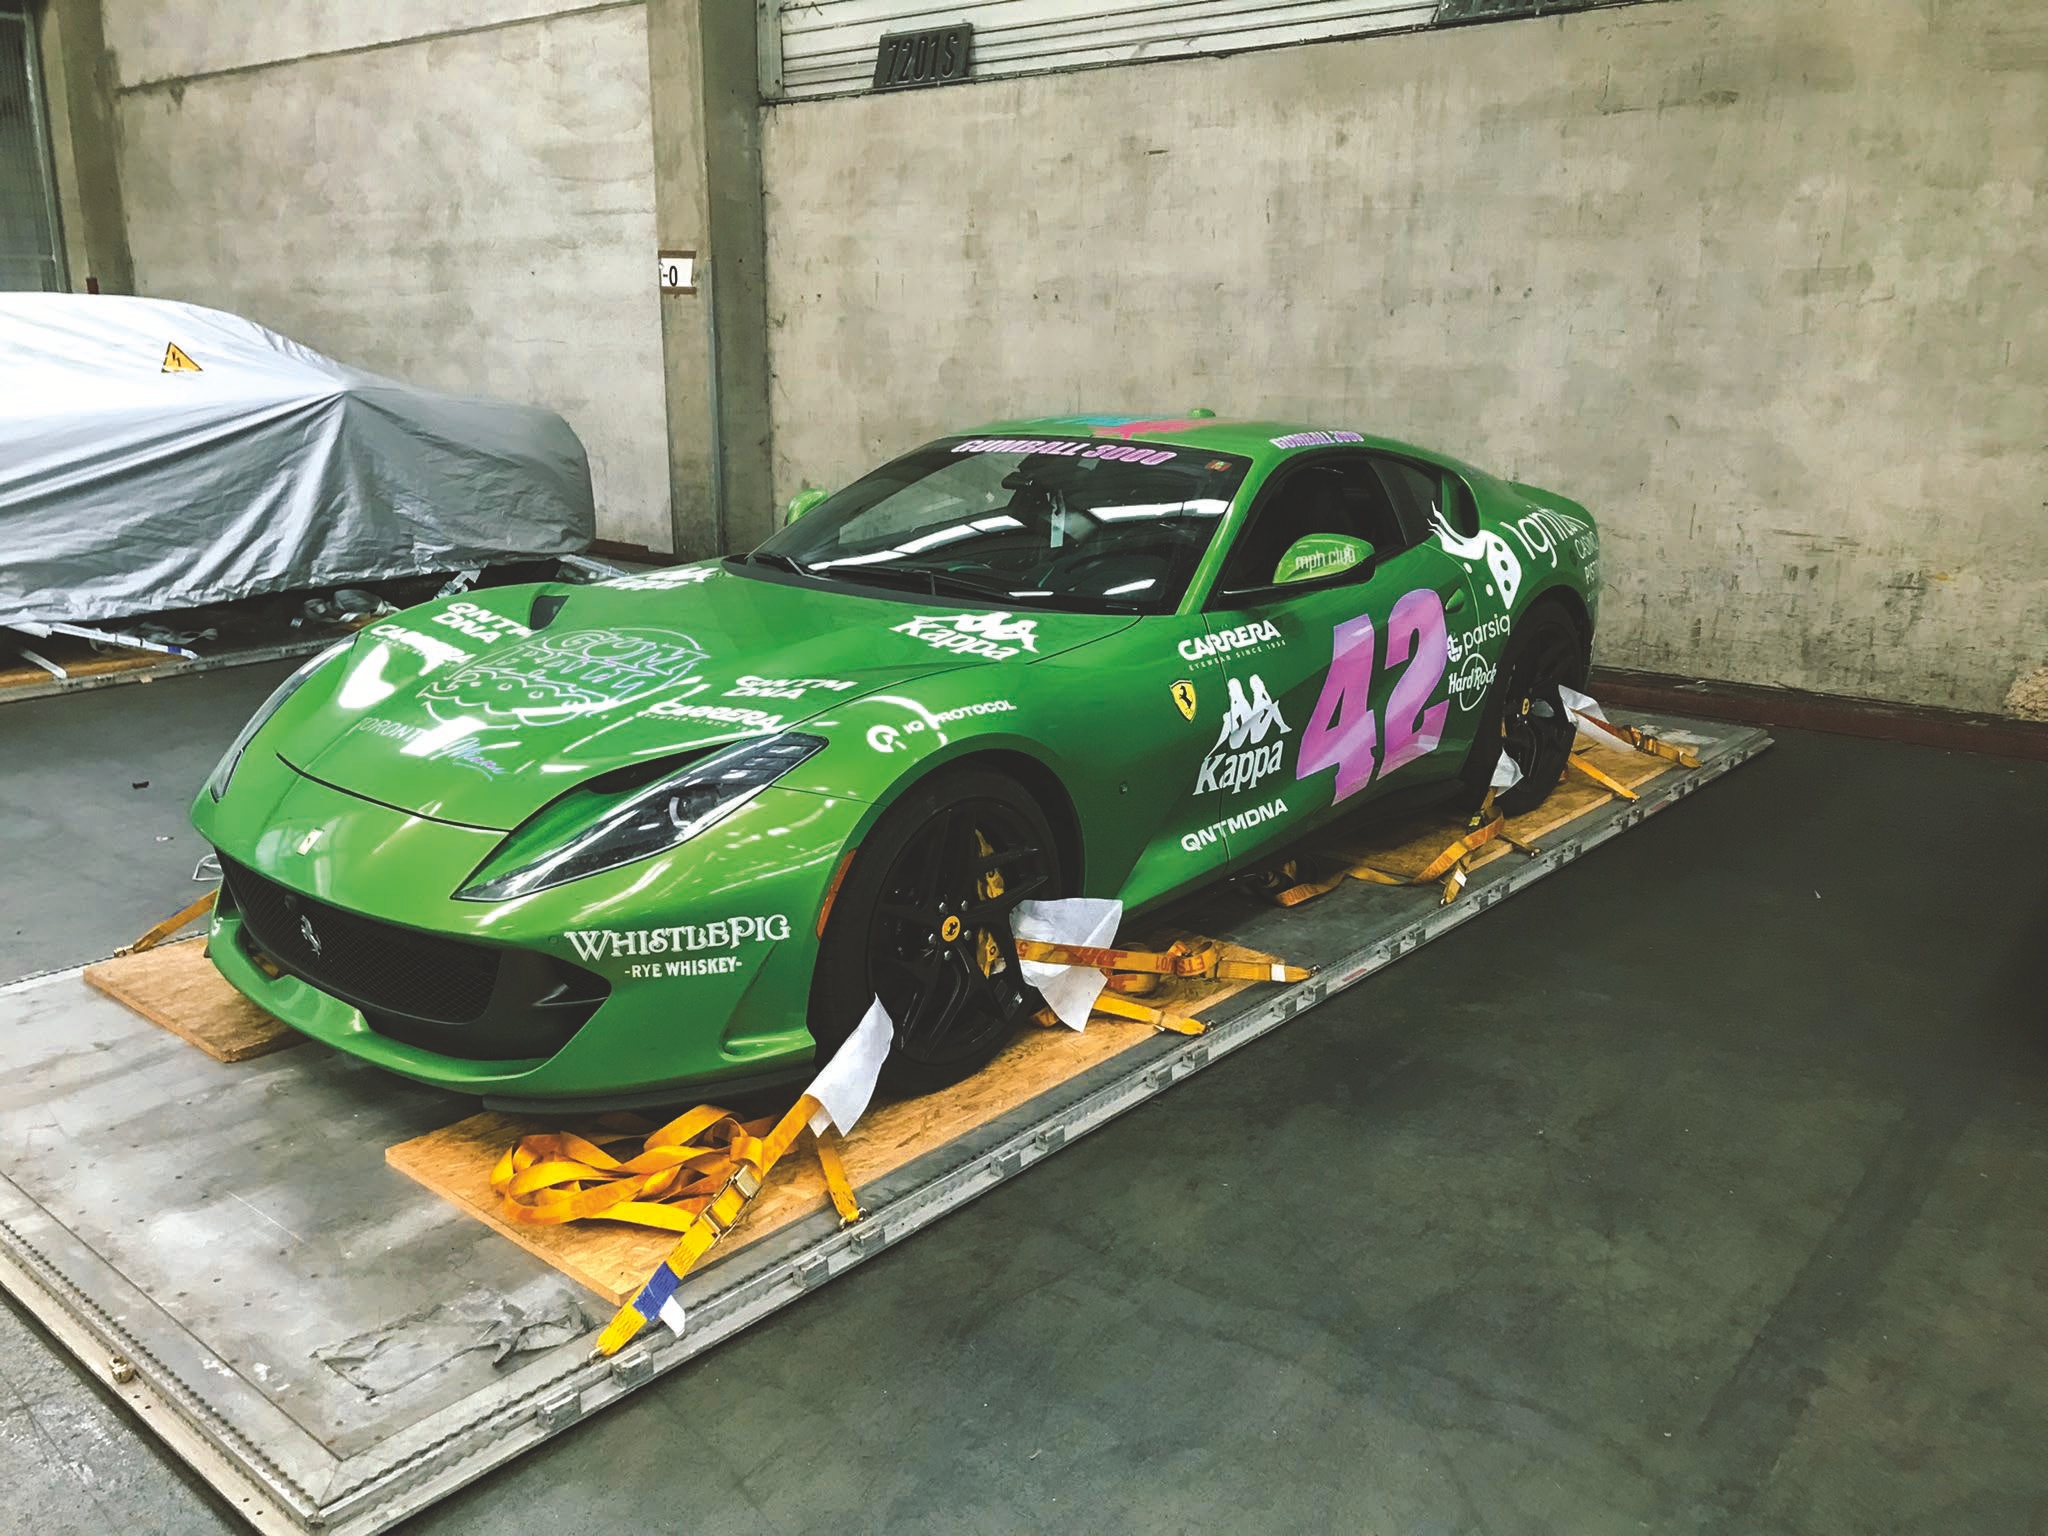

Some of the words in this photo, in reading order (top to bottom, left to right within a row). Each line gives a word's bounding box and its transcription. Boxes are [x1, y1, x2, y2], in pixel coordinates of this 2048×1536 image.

[1081, 444, 1178, 466] 3000
[431, 612, 503, 644] DNA
[889, 615, 1020, 661] Kappa
[1178, 619, 1282, 661] CARRERA
[1462, 613, 1511, 656] parsiq
[1295, 588, 1450, 807] 42
[1448, 668, 1475, 695] Hard
[1473, 662, 1497, 691] Rock
[1192, 739, 1285, 796] Kappa
[1180, 798, 1289, 853] QNTMDNA
